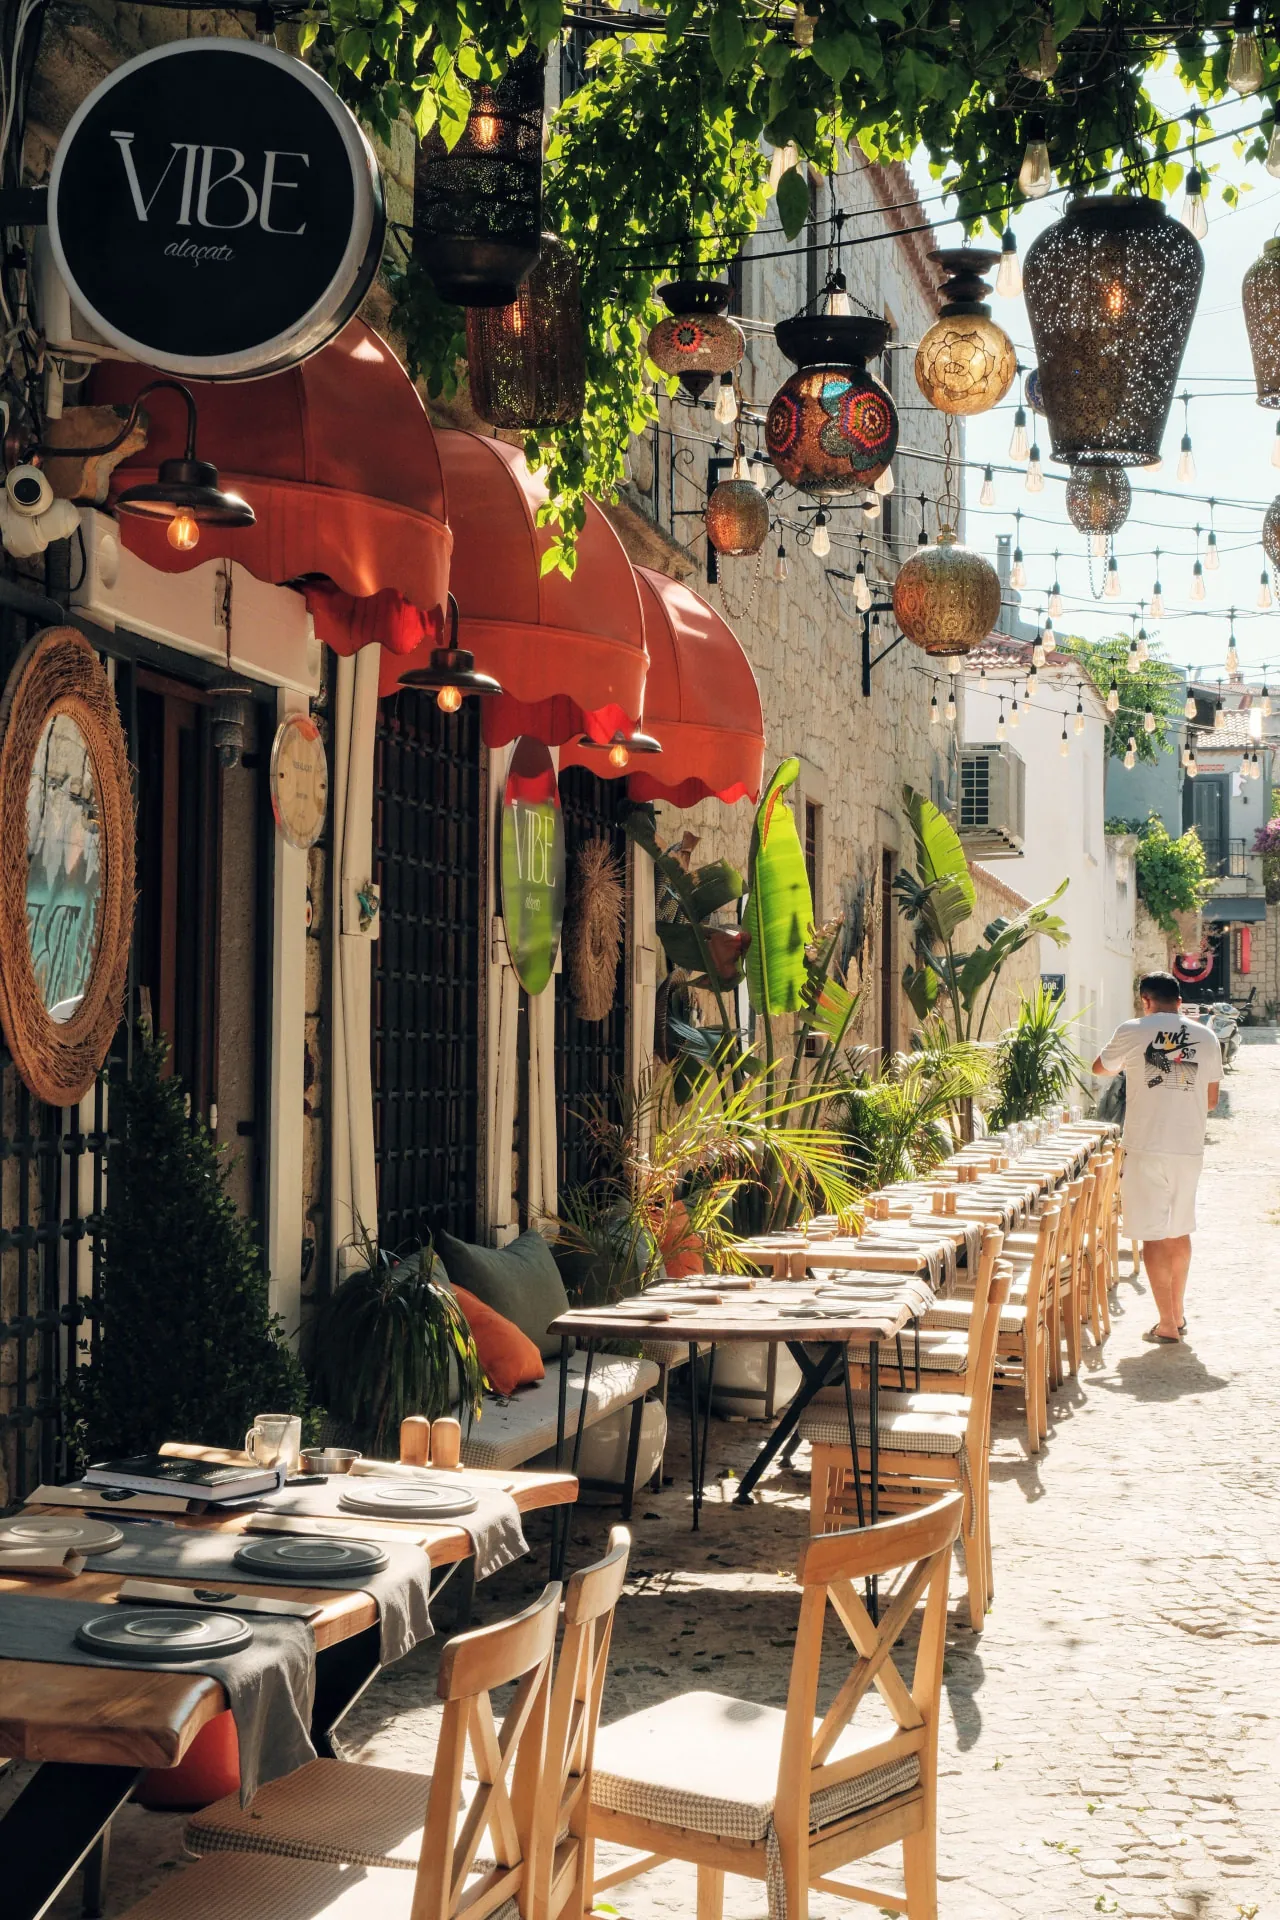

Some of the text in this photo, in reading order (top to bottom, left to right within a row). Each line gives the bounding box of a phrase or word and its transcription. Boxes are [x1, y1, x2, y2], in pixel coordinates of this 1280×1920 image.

[110, 130, 310, 235] VIBE
[511, 798, 556, 888] VIBE
[1154, 1030, 1190, 1045] NIKE
